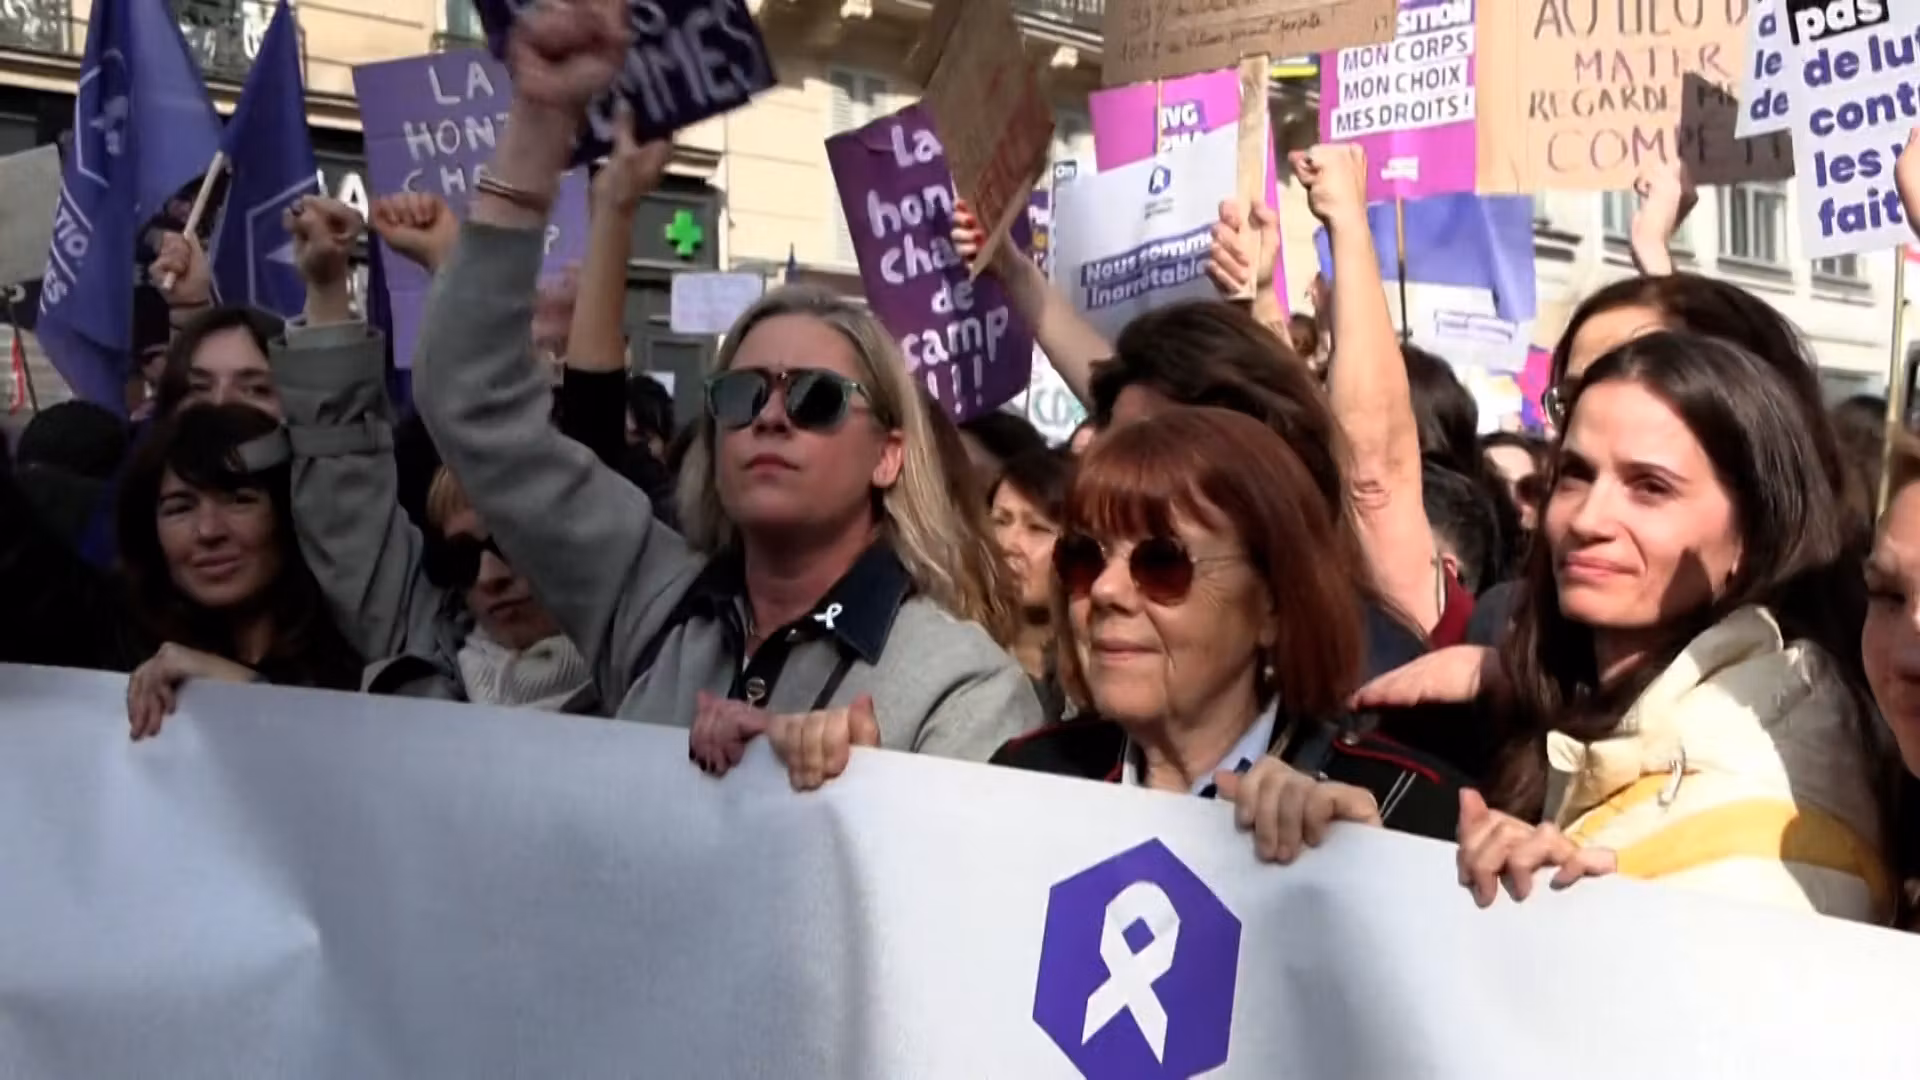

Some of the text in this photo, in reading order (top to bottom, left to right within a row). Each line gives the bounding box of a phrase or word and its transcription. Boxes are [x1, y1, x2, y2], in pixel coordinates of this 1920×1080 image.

[1795, 0, 1882, 42] pas
[1343, 31, 1468, 73] MON CORPS
[1754, 49, 1783, 80] le
[1802, 48, 1860, 87] de
[428, 61, 495, 105] LA
[1343, 64, 1461, 101] MON CHOIX
[1336, 107, 1374, 134] MES
[1379, 95, 1459, 127] DROITS
[1750, 88, 1790, 120] de
[1809, 81, 1920, 137] cont
[890, 125, 944, 167] La
[1813, 148, 1883, 188] les
[1817, 187, 1904, 237] fait
[1085, 252, 1137, 285] Nous
[931, 279, 975, 315] de
[901, 305, 1009, 374] camp
